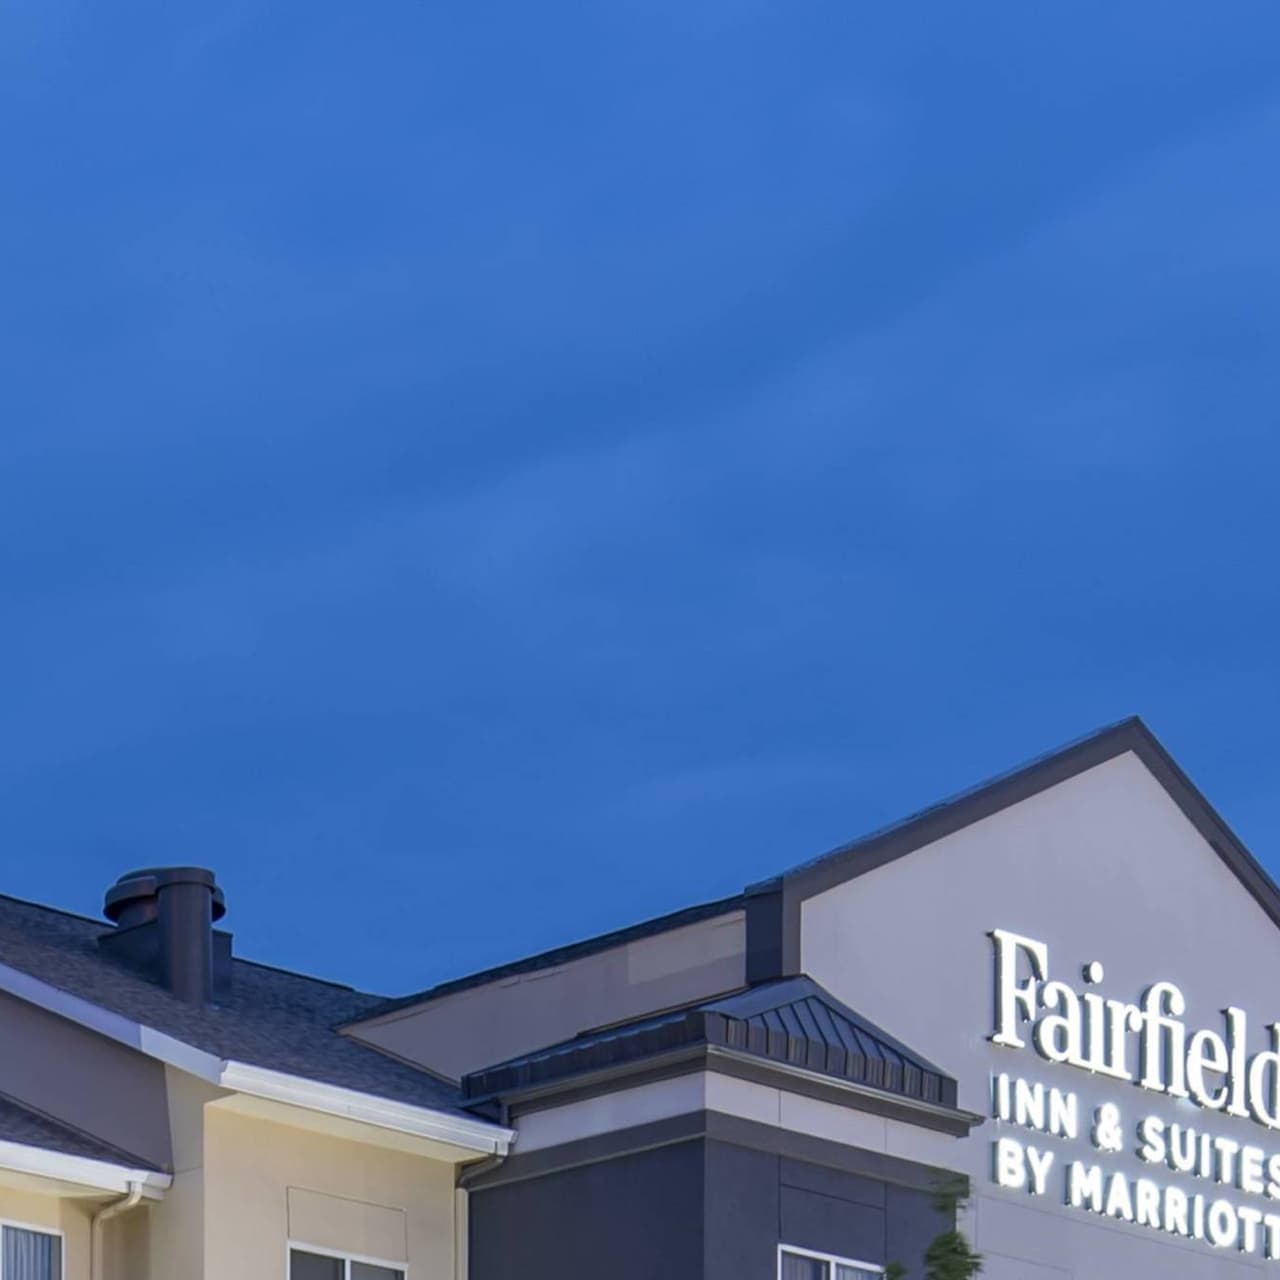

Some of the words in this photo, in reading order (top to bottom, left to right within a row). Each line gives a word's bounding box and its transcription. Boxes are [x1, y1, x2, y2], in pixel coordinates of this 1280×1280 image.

[994, 1073, 1077, 1138] INN
[1094, 1102, 1124, 1152] &
[993, 1137, 1054, 1195] BY
